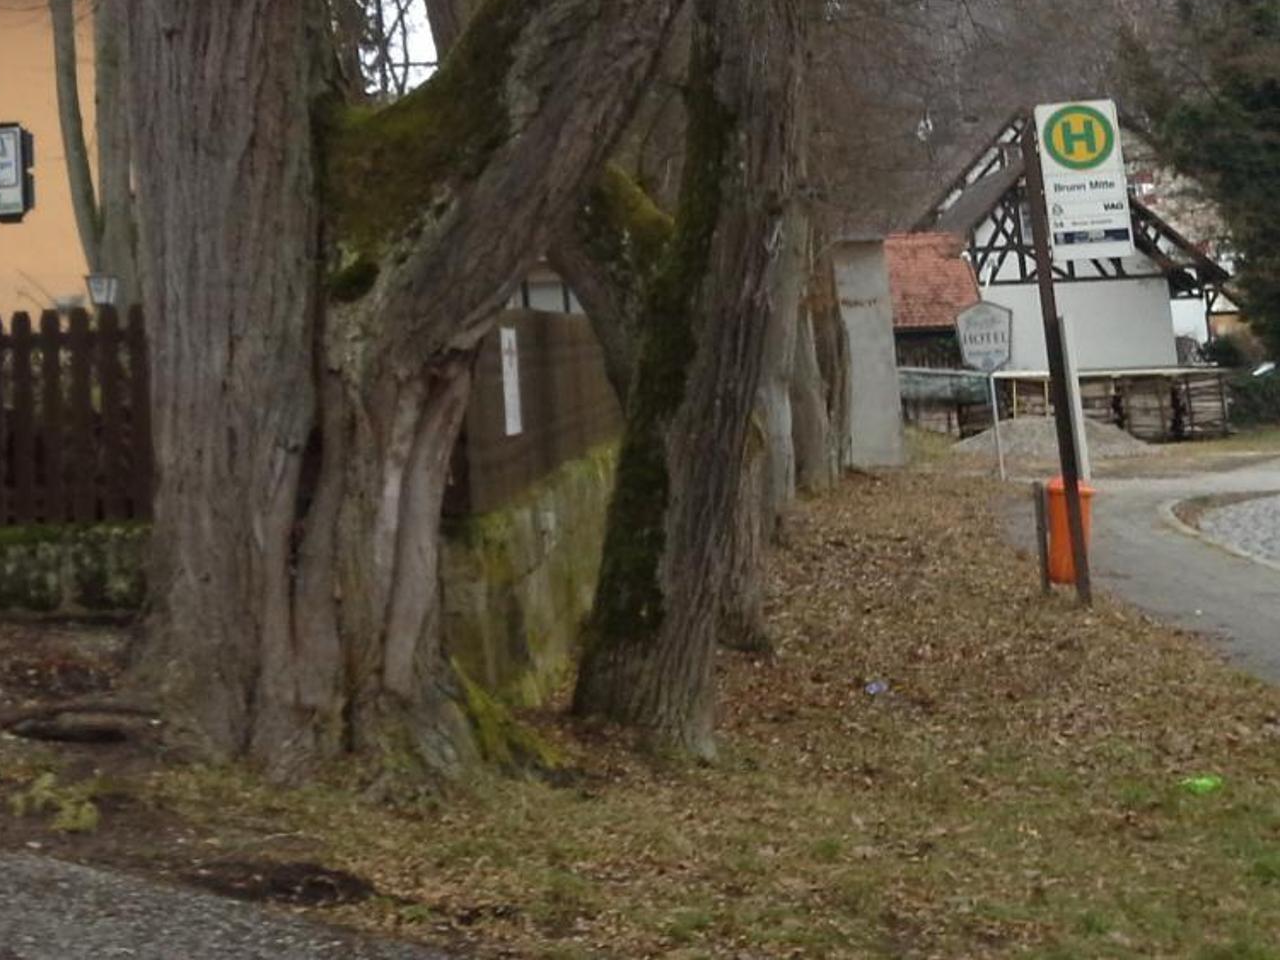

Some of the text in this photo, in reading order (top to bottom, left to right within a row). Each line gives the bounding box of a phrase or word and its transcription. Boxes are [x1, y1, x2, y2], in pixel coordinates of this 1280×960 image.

[1061, 119, 1097, 155] H
[1053, 180, 1115, 193] Brunn Mitte
[963, 331, 1005, 345] HOTEL
